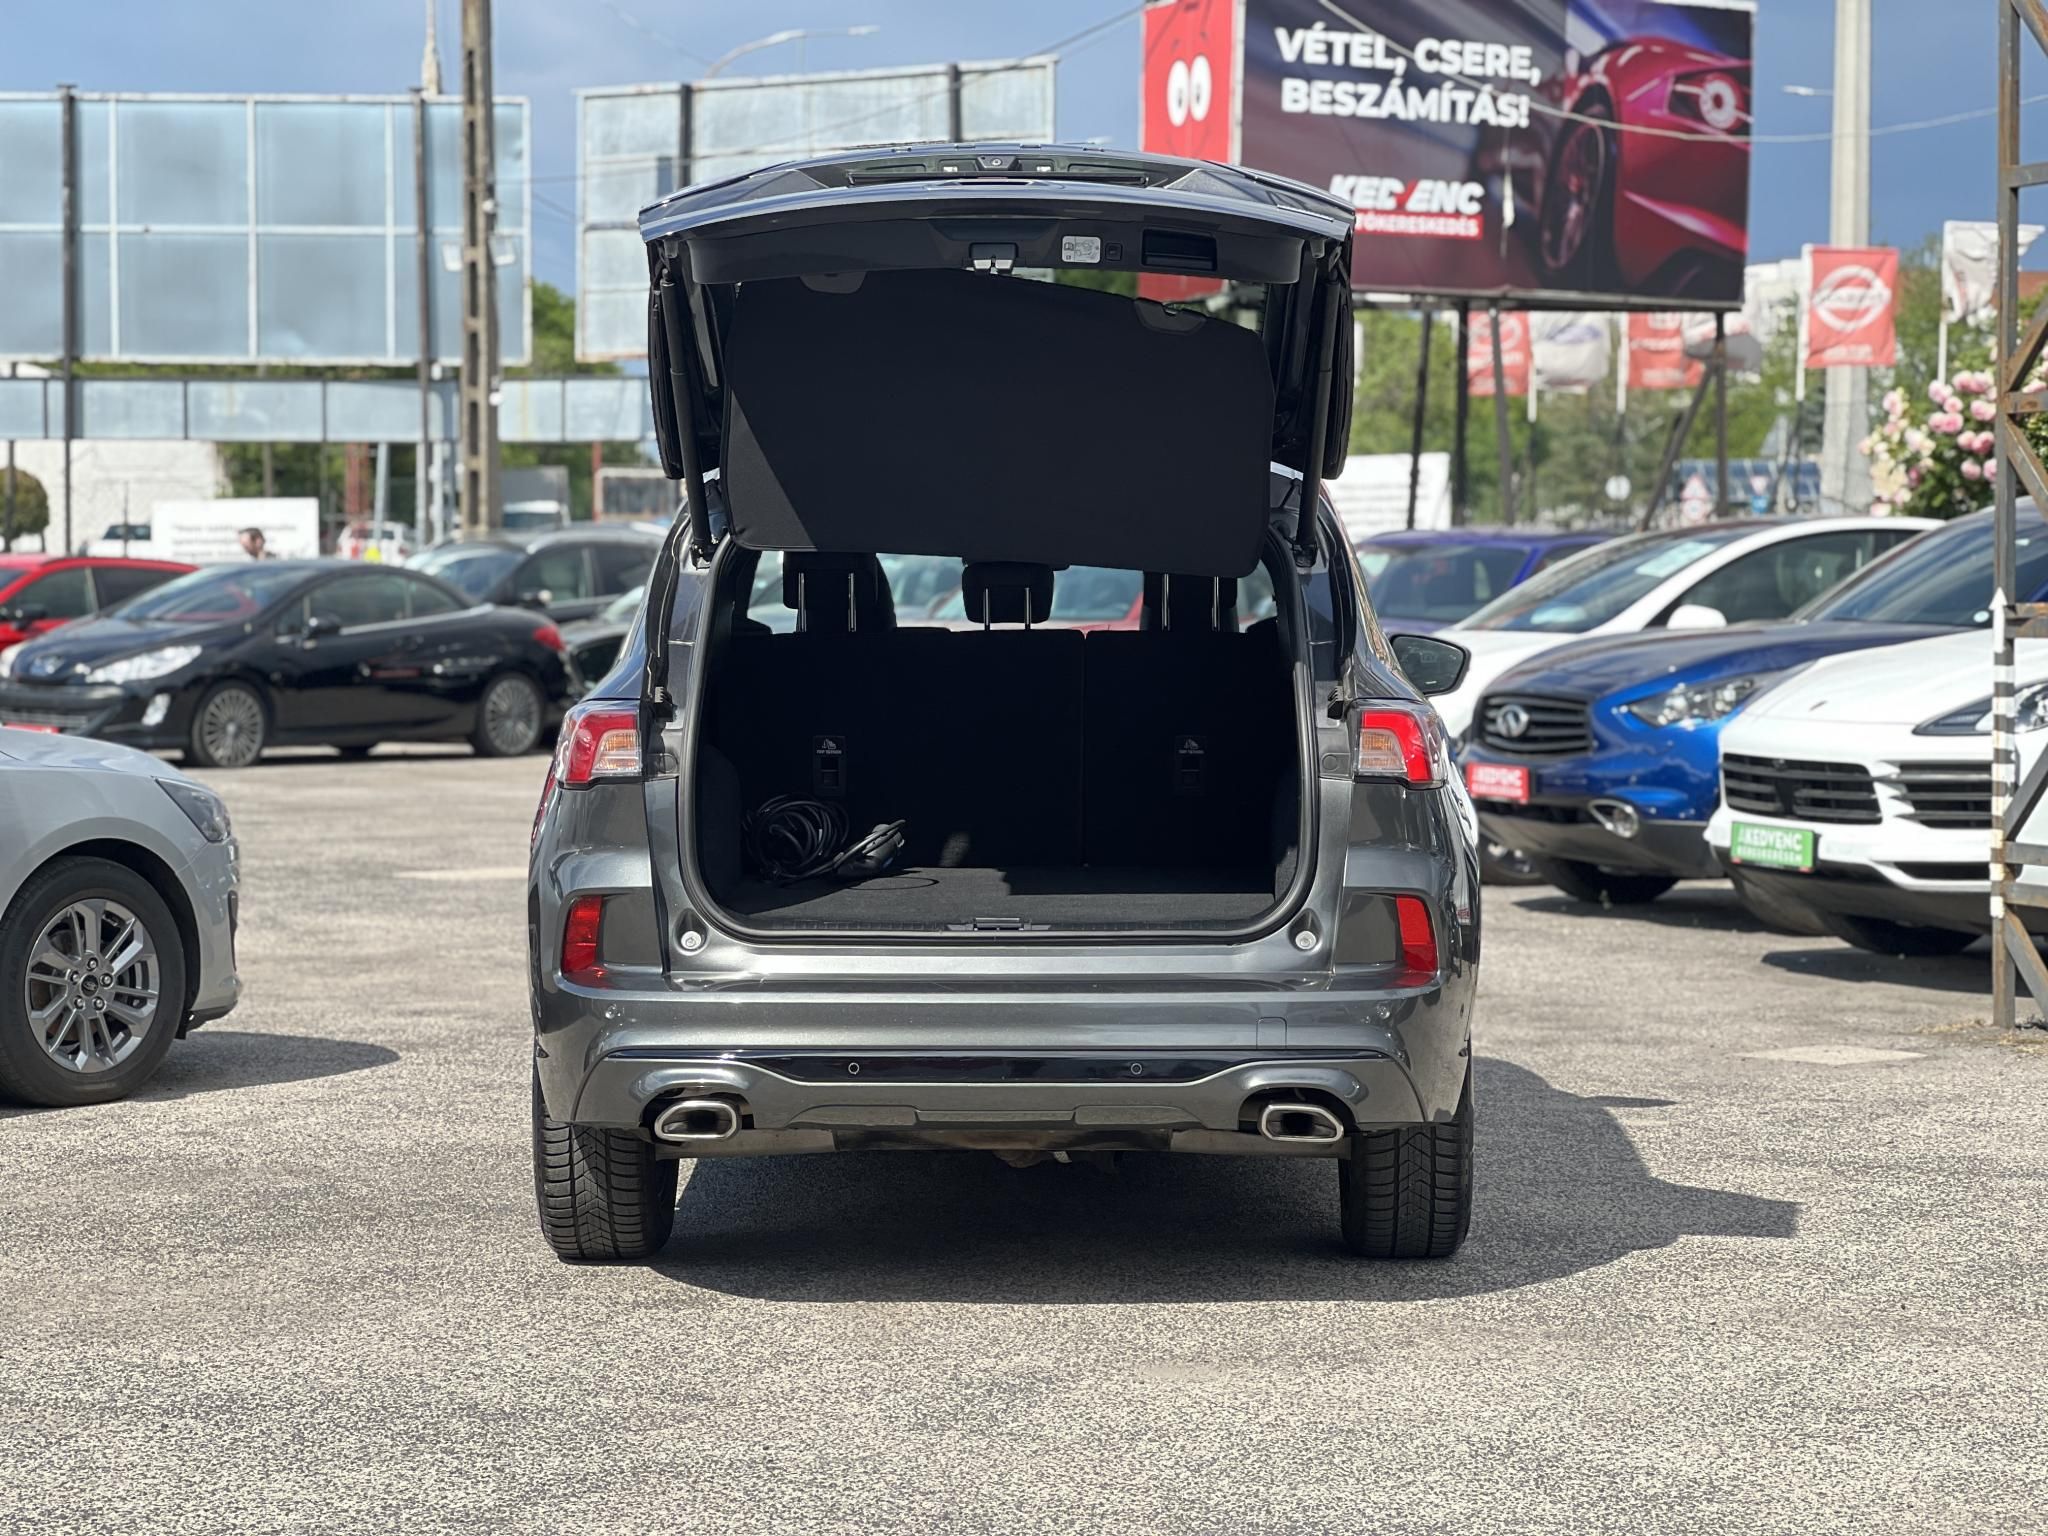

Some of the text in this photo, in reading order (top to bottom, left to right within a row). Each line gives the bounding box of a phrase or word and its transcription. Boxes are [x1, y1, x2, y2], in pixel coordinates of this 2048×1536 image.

[1274, 20, 1541, 87] VÉTEL, CSERE,
[1281, 77, 1531, 128] BESZÁMÍTÁS!
